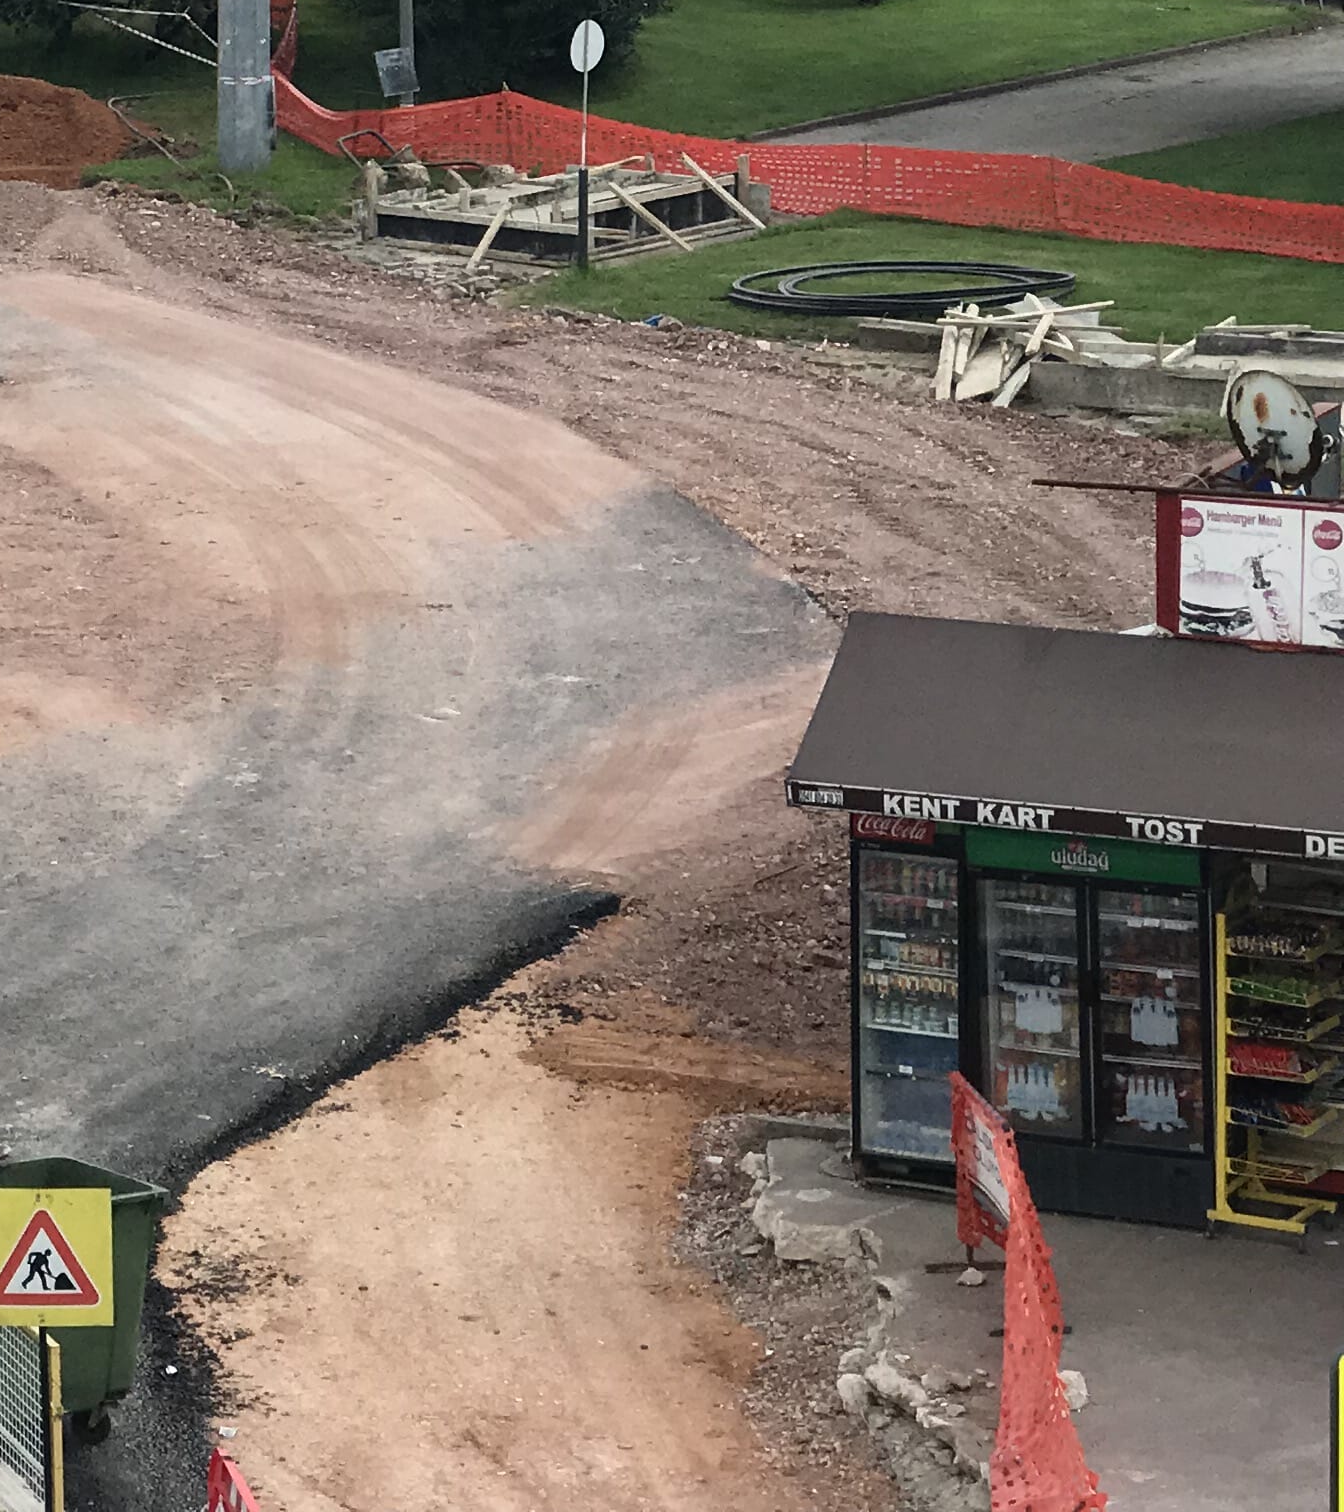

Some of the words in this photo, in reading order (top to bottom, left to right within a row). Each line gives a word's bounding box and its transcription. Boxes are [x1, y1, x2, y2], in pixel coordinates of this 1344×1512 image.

[883, 793, 960, 820] KENT
[977, 802, 1055, 830] KART
[1125, 816, 1203, 844] TOST
[1305, 834, 1344, 860] DE
